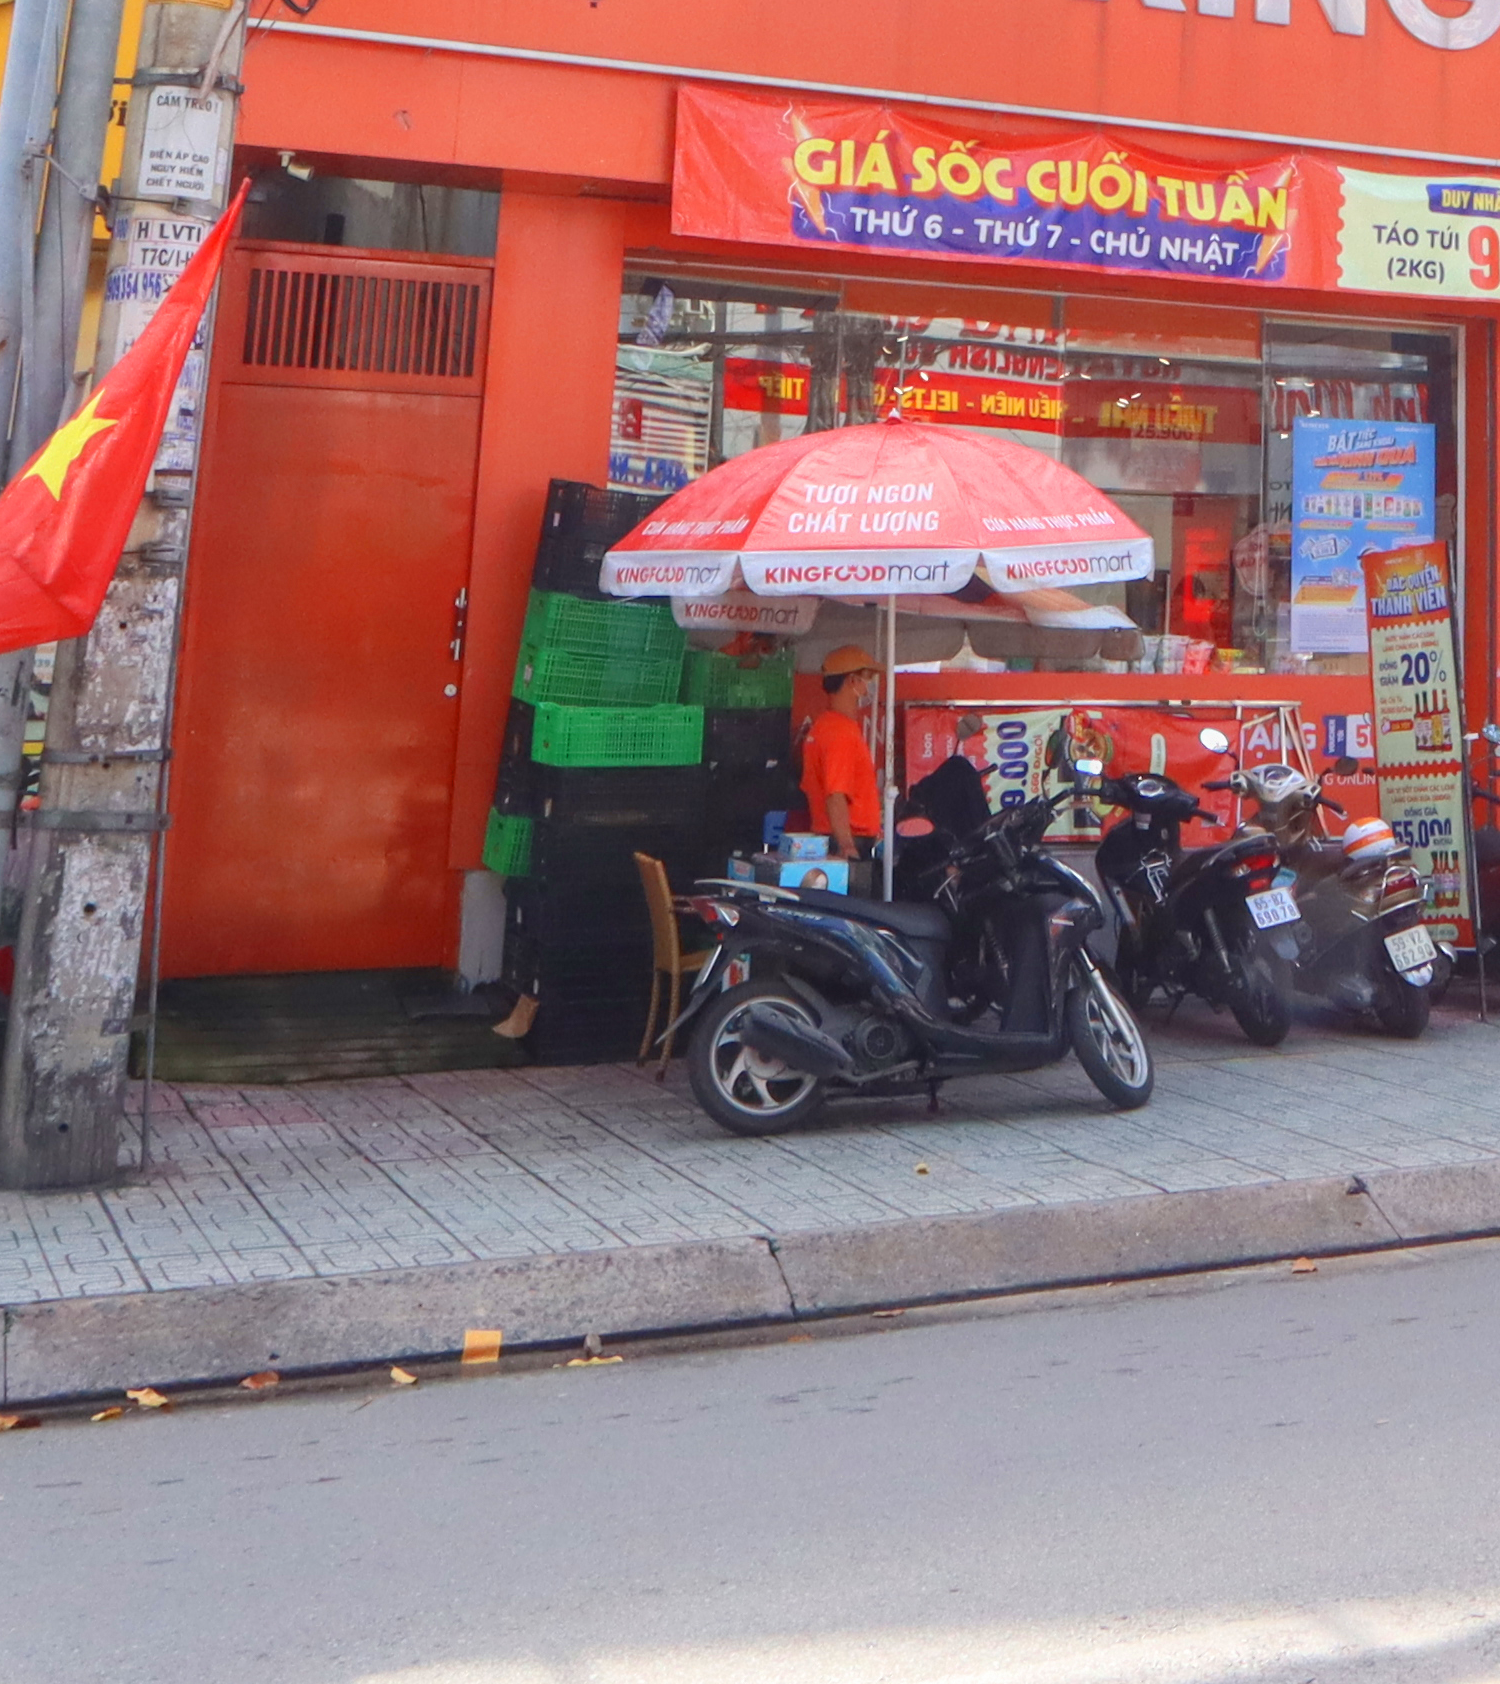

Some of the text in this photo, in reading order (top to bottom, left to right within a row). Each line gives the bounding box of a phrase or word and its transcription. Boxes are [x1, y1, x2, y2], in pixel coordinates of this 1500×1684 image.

[156, 90, 181, 107] CẤM
[794, 129, 1288, 231] GIÁ SỐC CUỐI TUẦN
[1442, 188, 1471, 209] DUY
[138, 221, 149, 240] H
[849, 205, 1239, 272] THỨ 6 THỨ 7 CHỦ NHẬT
[1373, 221, 1460, 251] TÁO TÚI
[1387, 256, 1446, 284] (2KG)
[804, 483, 934, 505] TƯƠI NGON
[788, 507, 940, 536] CHẤT LƯỢNG
[983, 506, 1116, 532] CỬA HÀNG THỰC PHẨM
[1415, 583, 1447, 613] VIÊN
[1401, 650, 1447, 686] 20%
[1337, 773, 1377, 786] ONLIN
